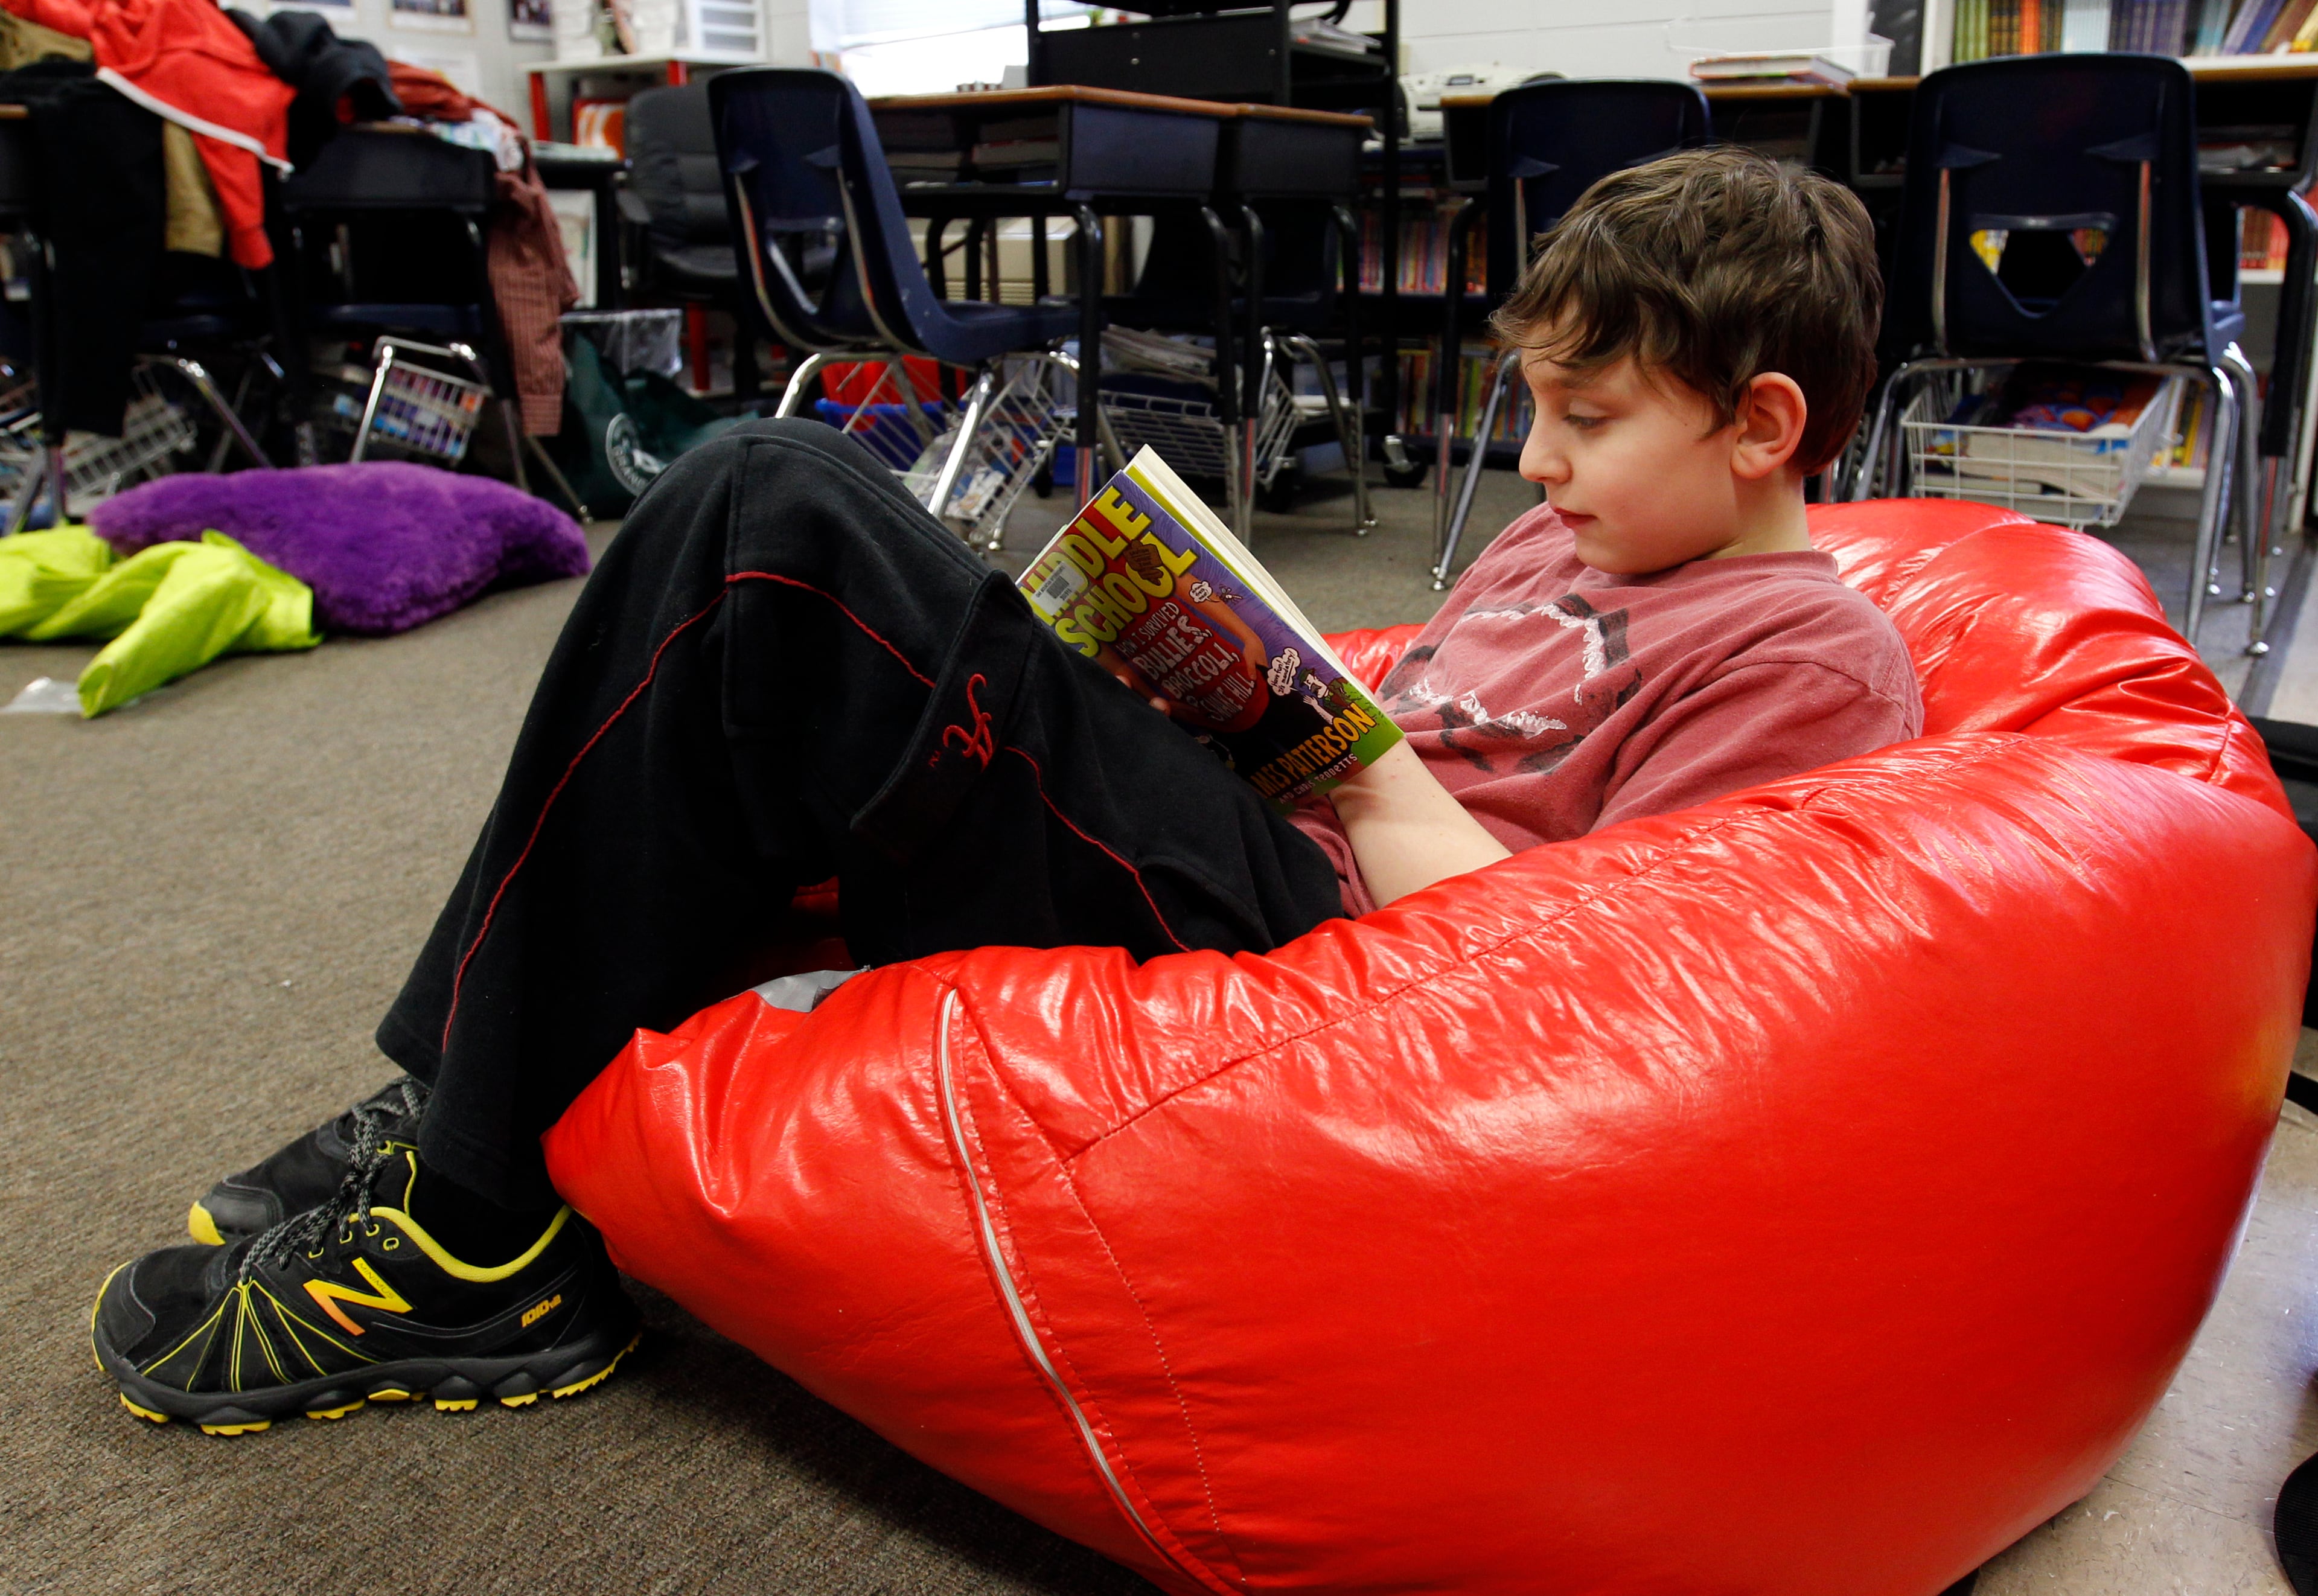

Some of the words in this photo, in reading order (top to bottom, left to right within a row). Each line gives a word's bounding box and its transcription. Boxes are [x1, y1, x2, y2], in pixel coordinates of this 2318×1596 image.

[1055, 531, 1198, 657] SCHOOL
[1132, 633, 1146, 645] I
[1138, 602, 1180, 640] SURVIVED
[1116, 637, 1138, 658] HOW
[1161, 642, 1240, 700] BROCCOLI,
[1274, 659, 1284, 674] fun!
[1222, 671, 1255, 703] HILL
[1276, 702, 1376, 780] PATTERSON
[358, 1262, 395, 1299] MINIMUS
